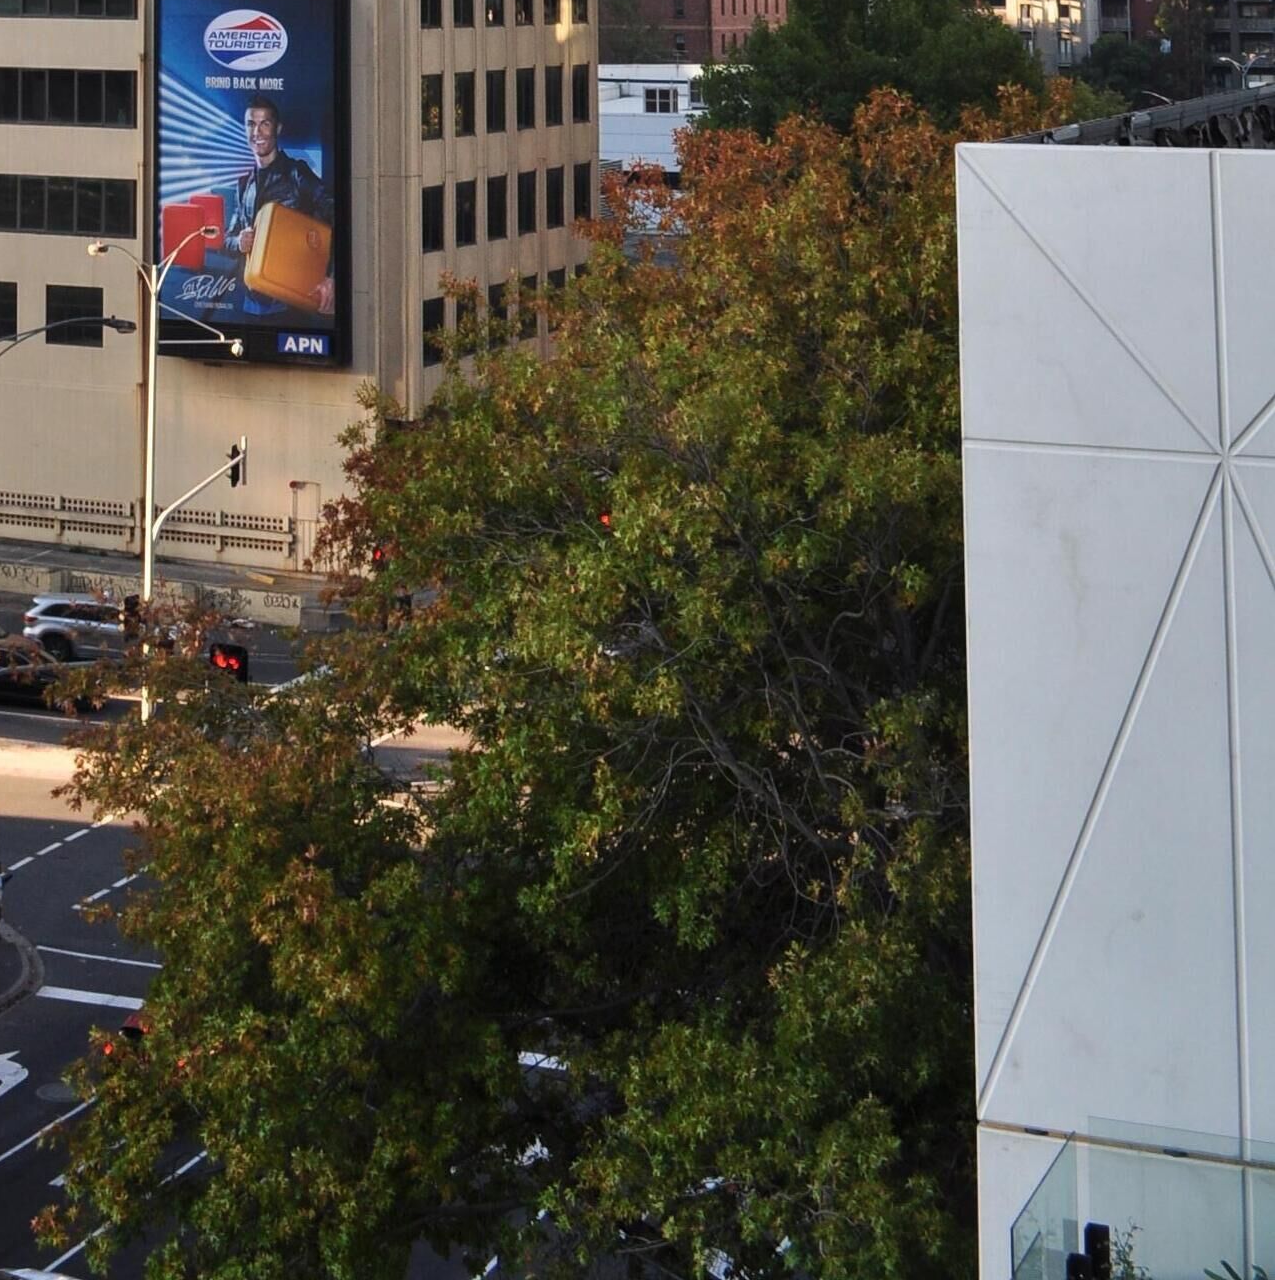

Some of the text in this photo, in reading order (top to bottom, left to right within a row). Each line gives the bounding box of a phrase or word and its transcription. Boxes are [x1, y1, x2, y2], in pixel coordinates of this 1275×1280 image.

[208, 31, 282, 41] AMERICAN
[207, 40, 283, 49] TOURISTER
[233, 76, 257, 90] BACK
[259, 77, 284, 91] MORE
[284, 336, 323, 354] APN
